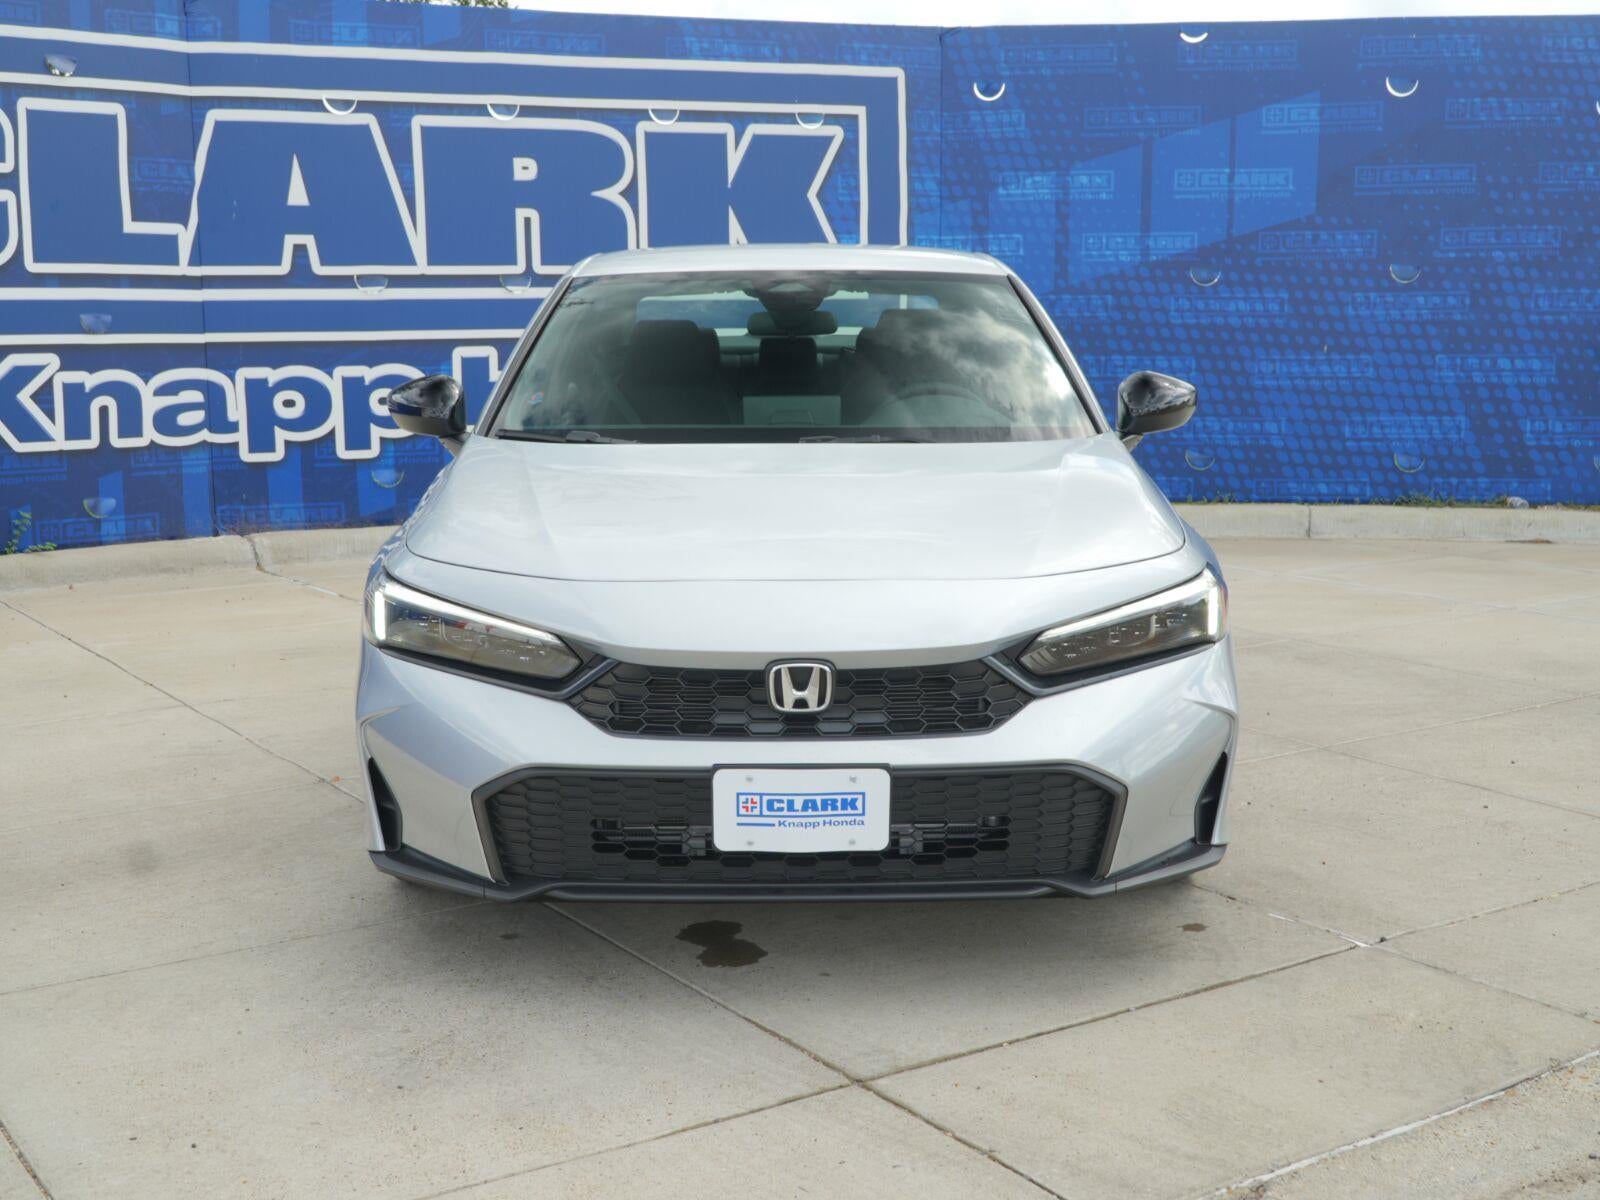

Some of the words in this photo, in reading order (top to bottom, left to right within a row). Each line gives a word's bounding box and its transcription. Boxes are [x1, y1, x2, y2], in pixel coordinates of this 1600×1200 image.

[0, 95, 845, 278] LARK
[766, 797, 859, 813] CLARK
[778, 820, 821, 829] Knapp
[822, 818, 865, 827] Honda
